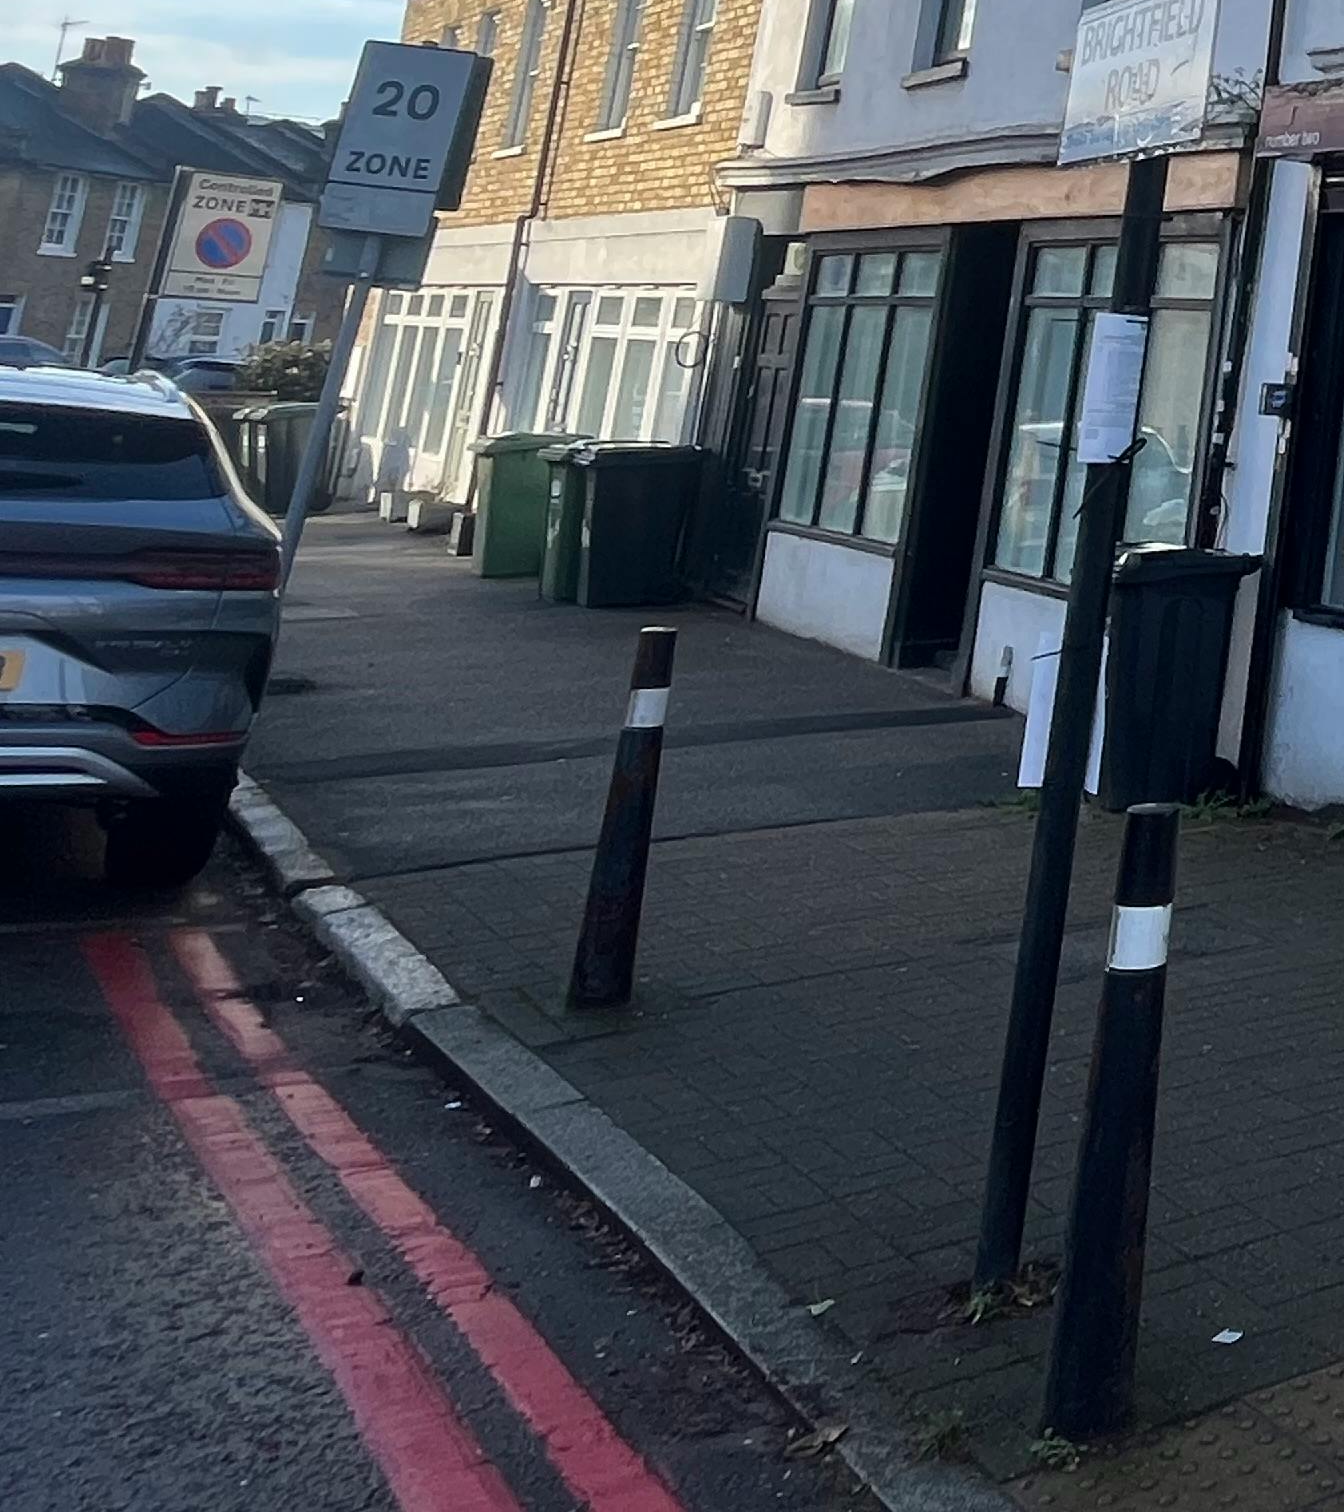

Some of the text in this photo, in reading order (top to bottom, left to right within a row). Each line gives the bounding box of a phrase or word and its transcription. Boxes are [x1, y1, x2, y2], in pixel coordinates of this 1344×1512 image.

[371, 80, 441, 121] 20
[345, 151, 432, 180] ZONE
[199, 178, 275, 197] Controlled
[191, 195, 248, 215] ZONE
